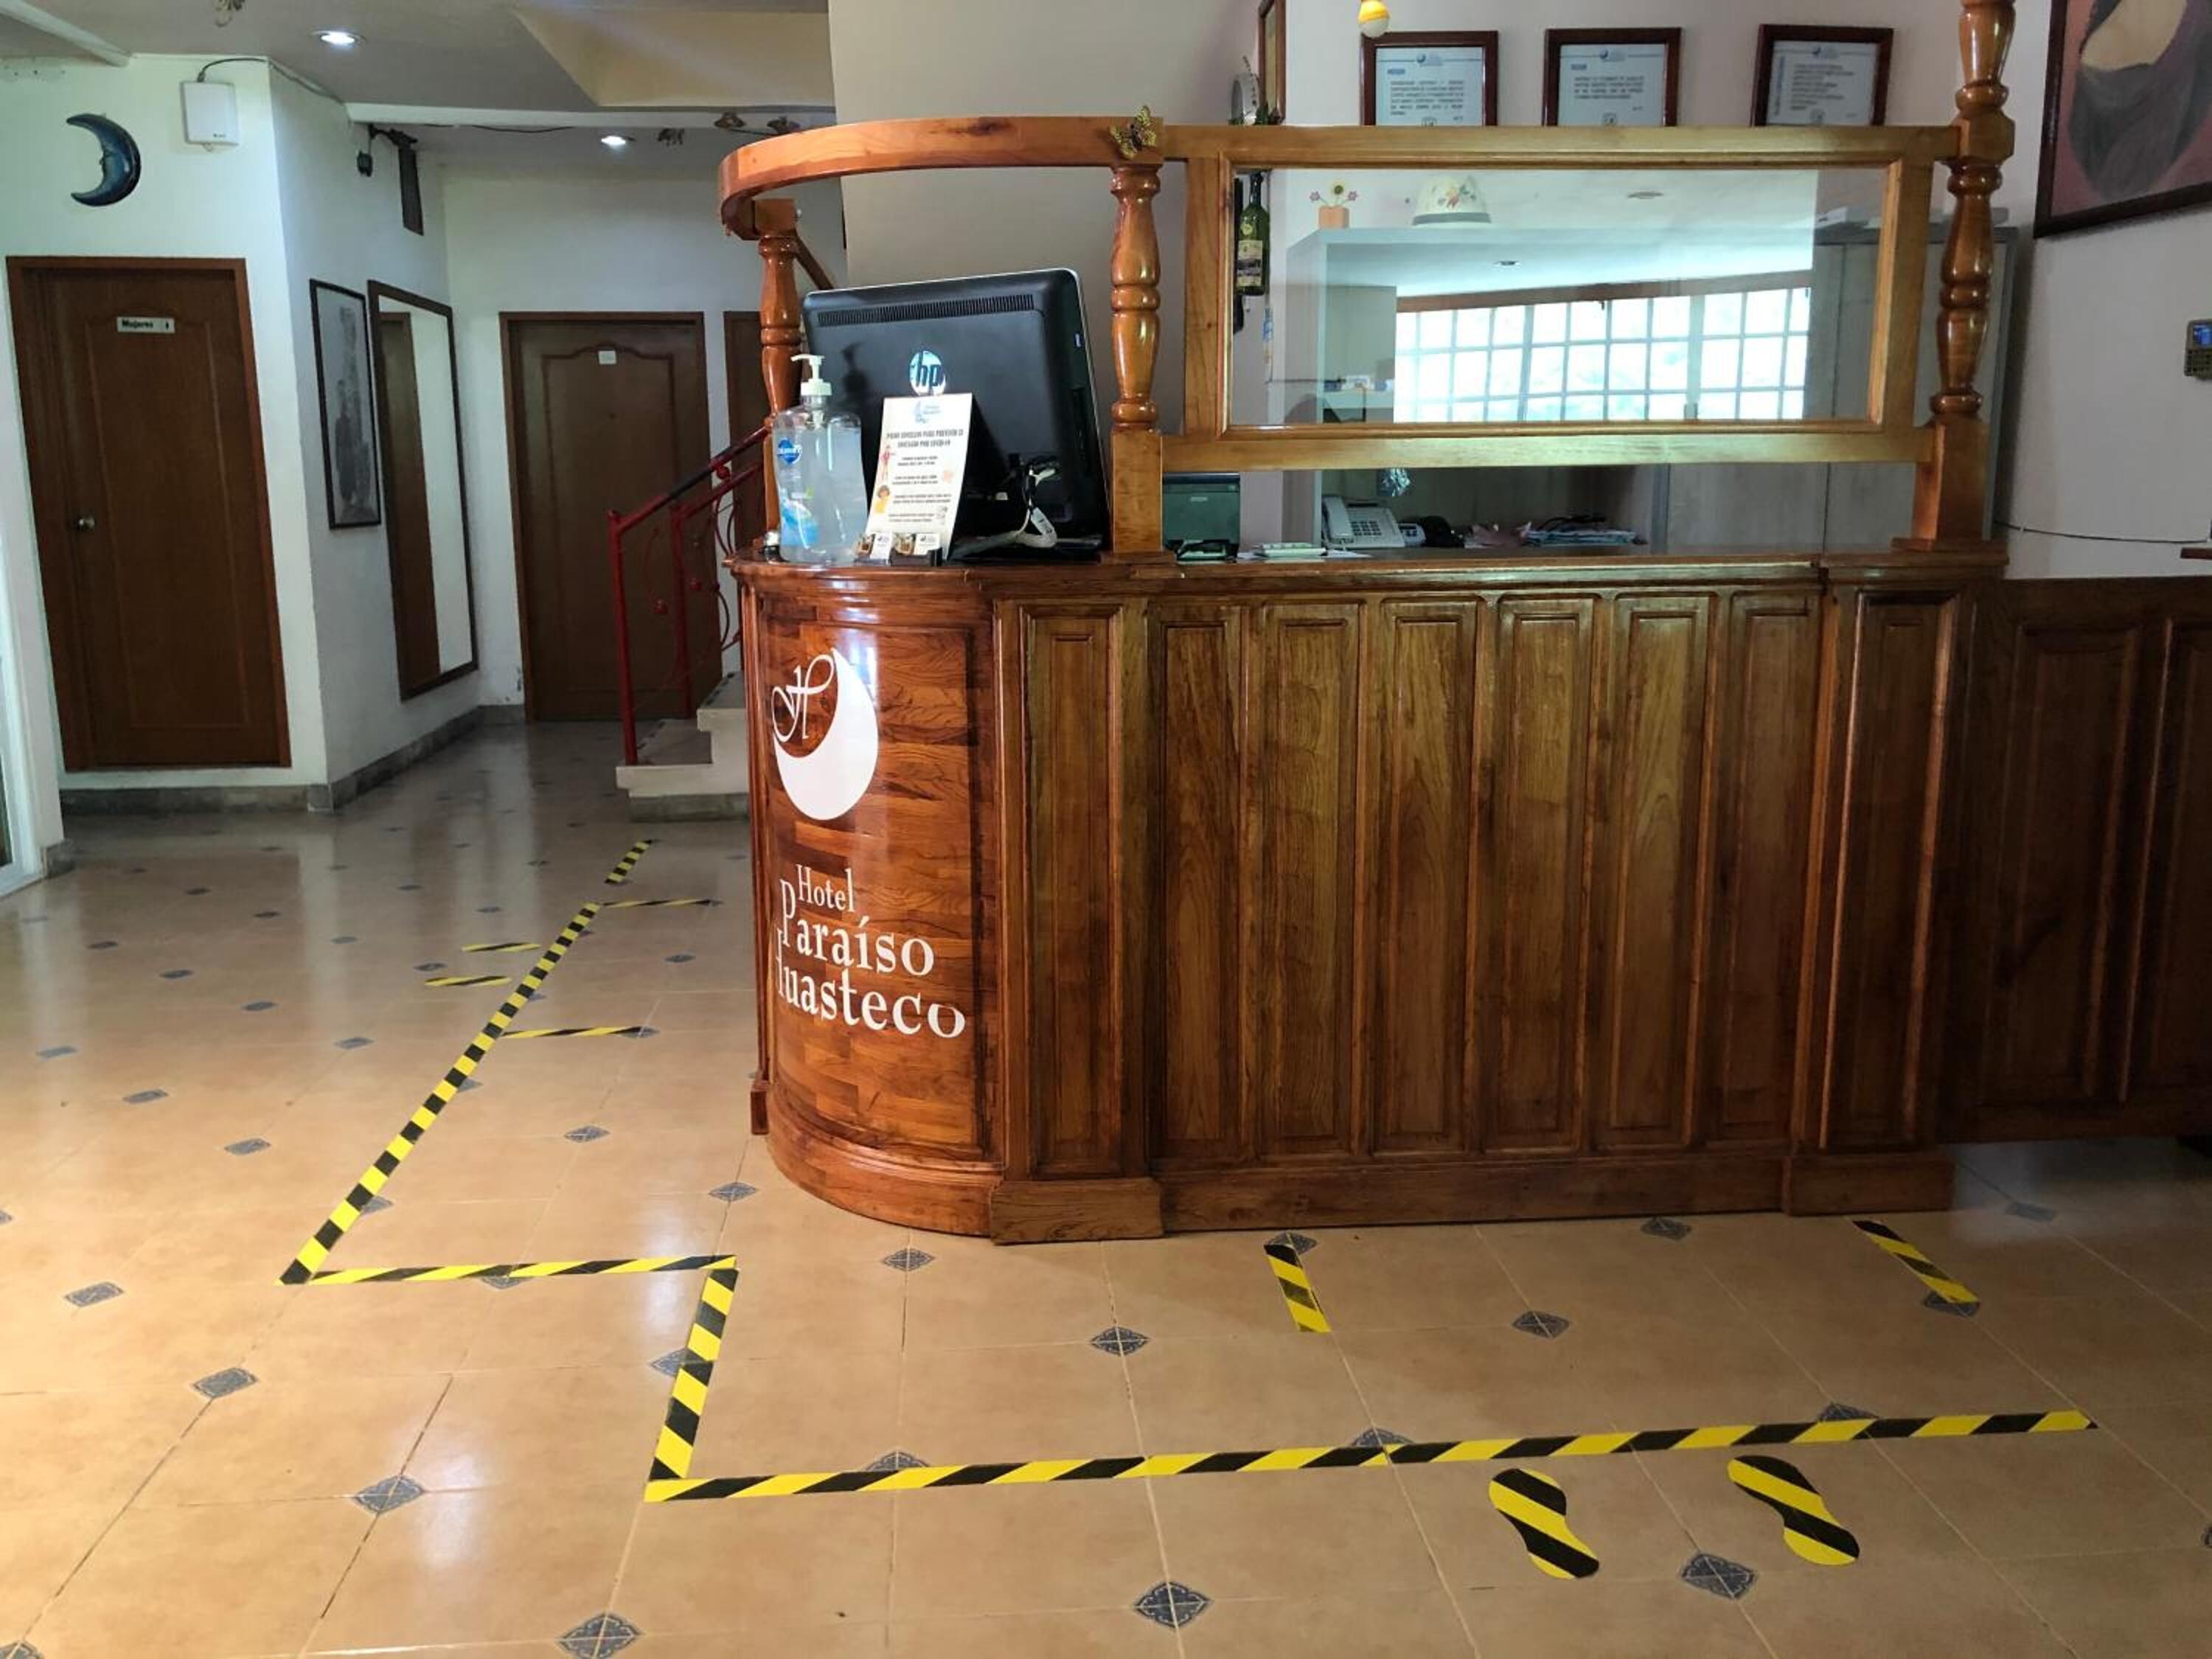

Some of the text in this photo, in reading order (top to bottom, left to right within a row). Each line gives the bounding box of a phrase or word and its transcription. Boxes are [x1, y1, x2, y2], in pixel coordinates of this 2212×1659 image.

[122, 319, 153, 329] Mujeres
[916, 349, 944, 394] hp
[796, 863, 855, 912] Hotel
[779, 878, 934, 976] Paraíso
